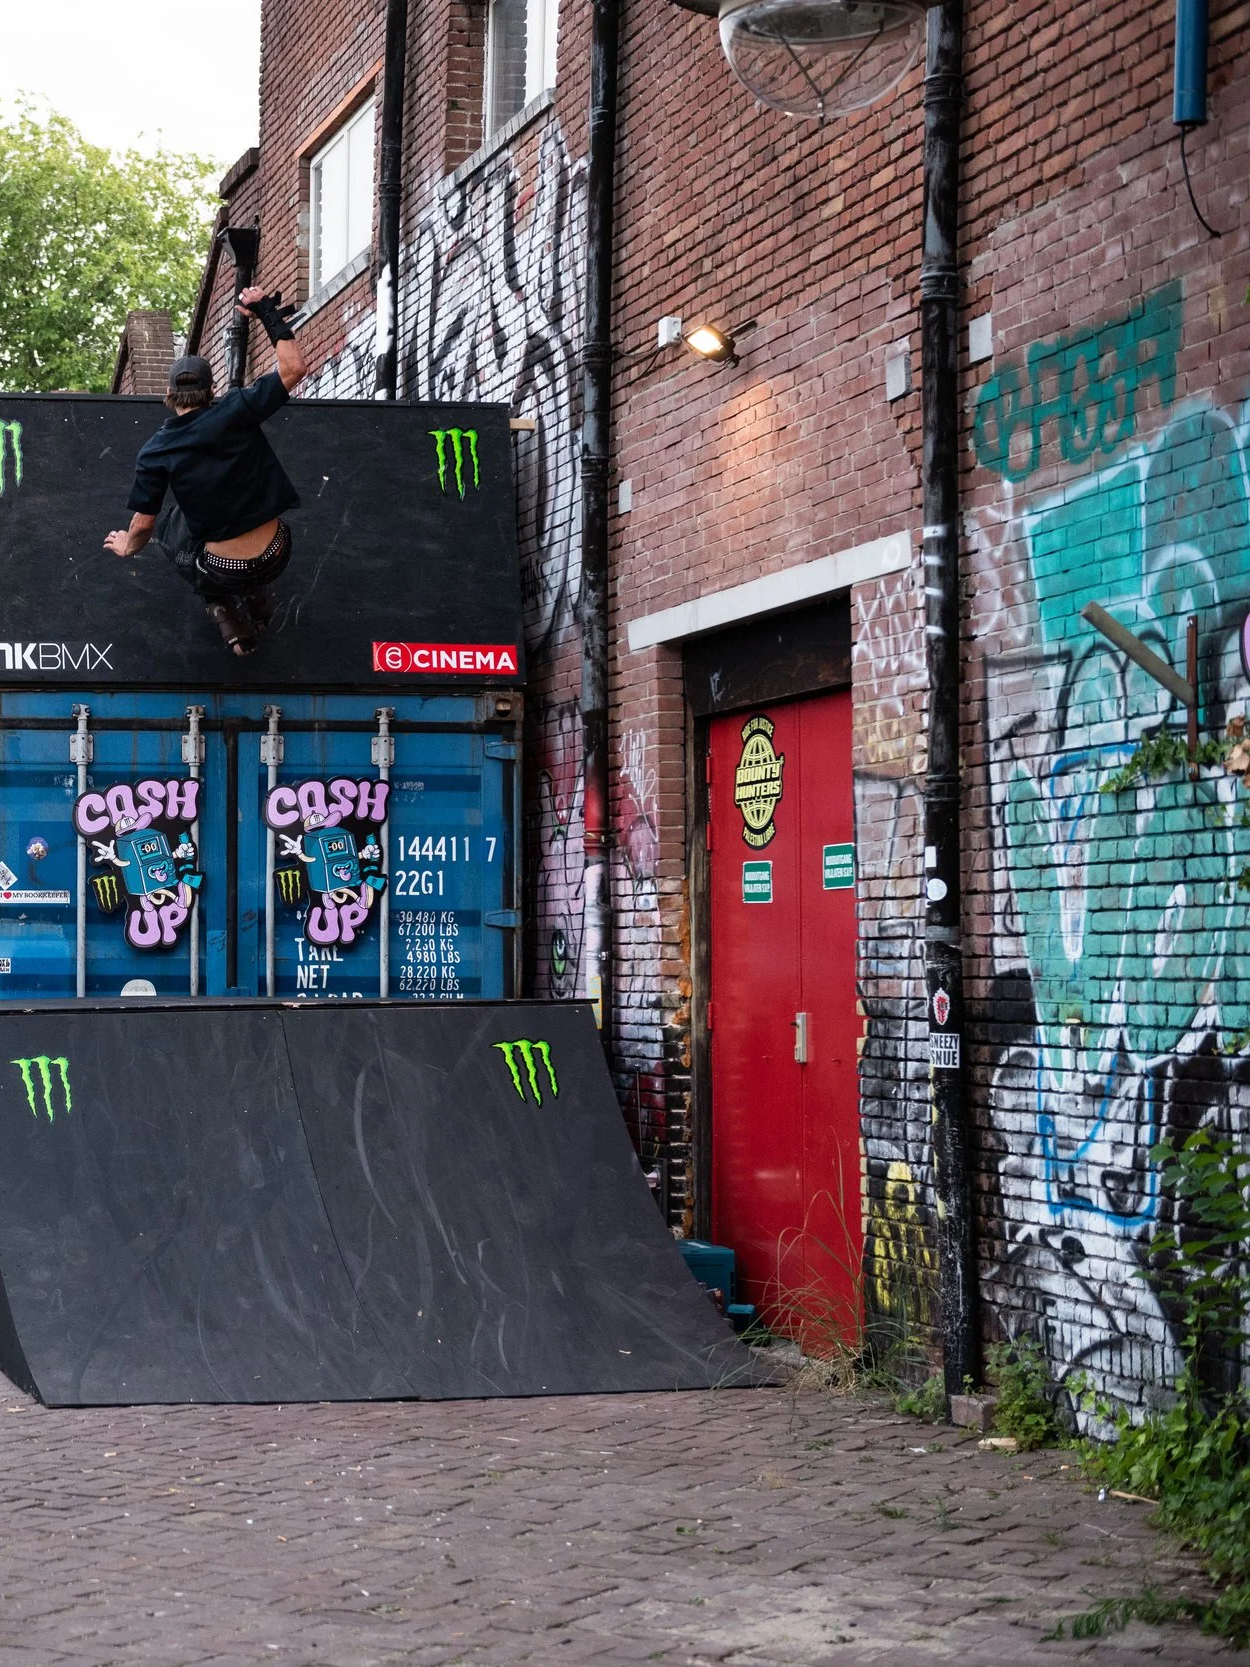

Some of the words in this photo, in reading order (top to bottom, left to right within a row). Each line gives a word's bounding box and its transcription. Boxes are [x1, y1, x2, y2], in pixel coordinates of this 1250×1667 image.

[413, 649, 515, 670] CINEMA
[737, 763, 780, 785] BOUNTY
[736, 781, 780, 800] HUNTERS
[77, 780, 200, 834] CASH
[267, 779, 389, 826] CASH
[398, 836, 470, 861] 144411
[485, 837, 497, 862] 7
[395, 870, 444, 896] 22G1
[24, 891, 68, 899] BOOKKEEPER
[129, 906, 188, 946] UP
[308, 903, 369, 944] UP
[399, 911, 436, 923] 30.480
[440, 911, 455, 923] KG
[439, 923, 459, 936] LBS
[440, 938, 454, 951] KG
[441, 951, 461, 964] LBS
[296, 965, 330, 989] NET
[400, 965, 437, 979] 28.220
[441, 965, 455, 979] KG
[440, 979, 460, 991] LBS
[930, 1034, 959, 1050] SNEEZY
